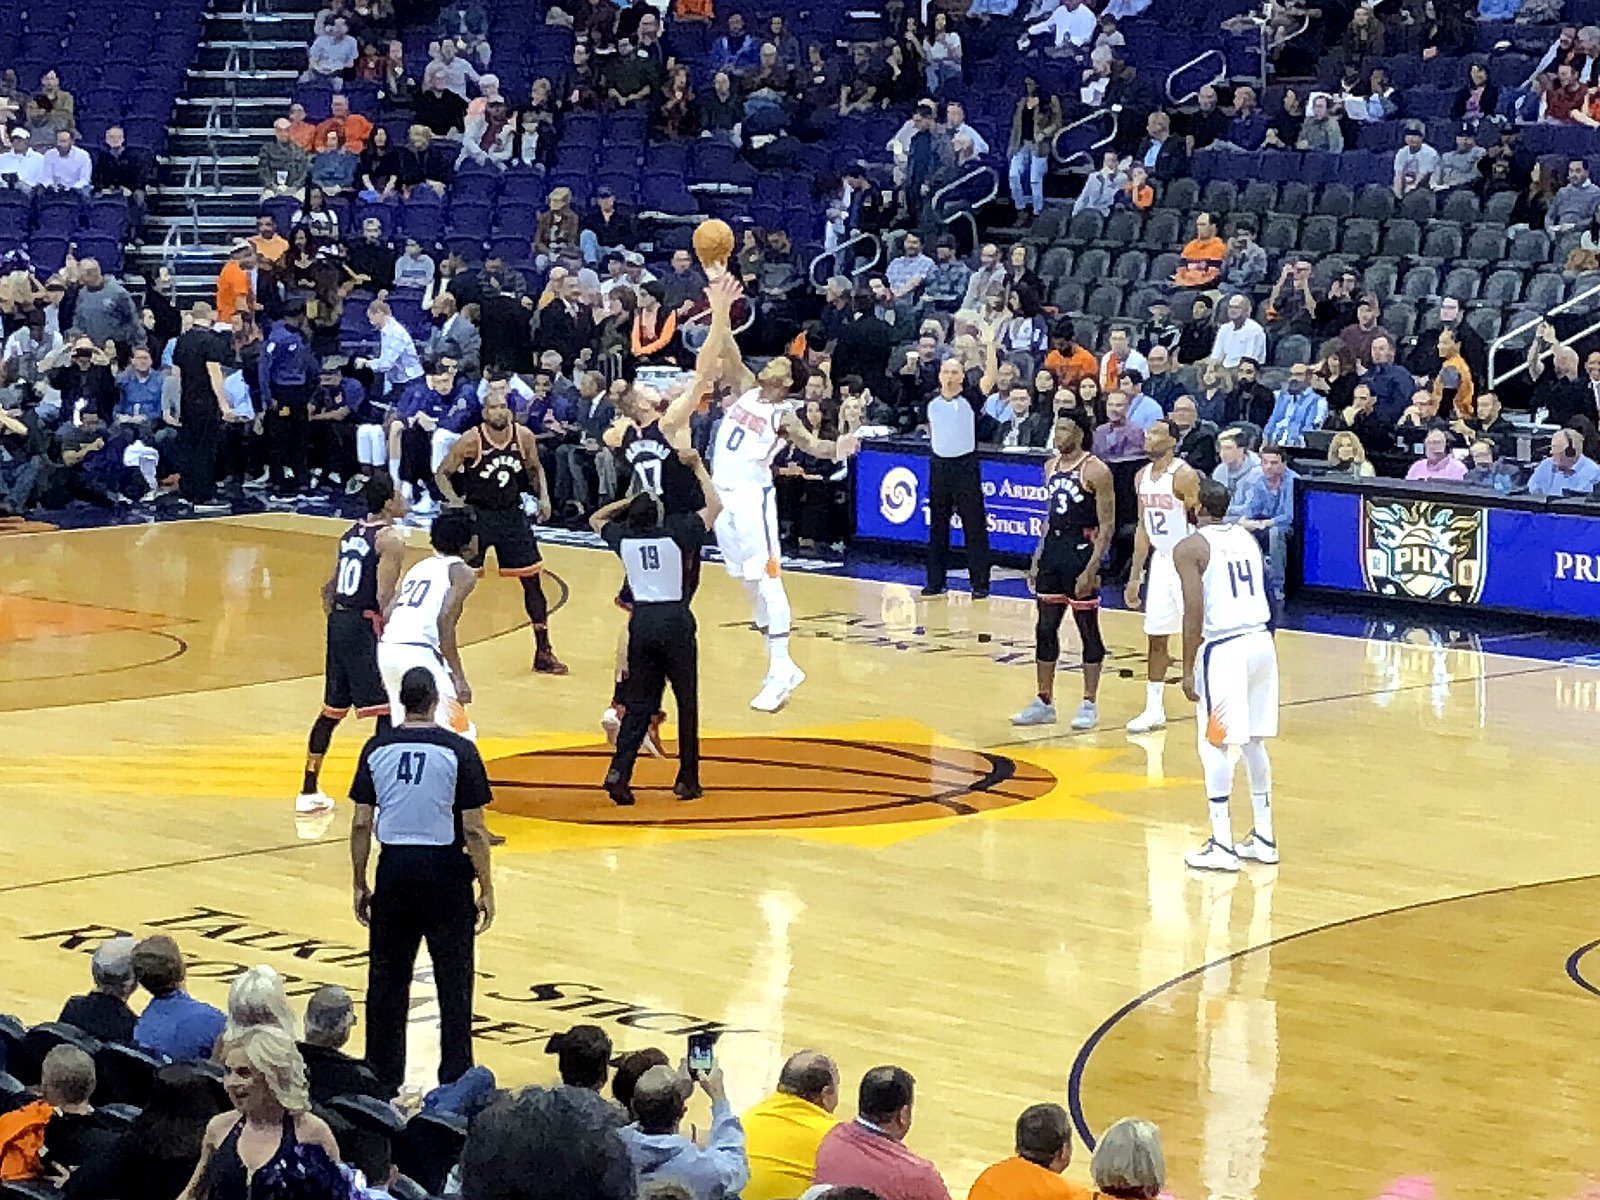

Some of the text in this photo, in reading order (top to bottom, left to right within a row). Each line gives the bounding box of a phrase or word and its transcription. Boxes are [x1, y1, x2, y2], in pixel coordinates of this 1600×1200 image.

[726, 426, 746, 452] 0
[497, 470, 510, 488] 9
[634, 459, 665, 496] 17
[999, 478, 1050, 501] ARIZO
[1056, 493, 1068, 515] 3
[1147, 510, 1169, 536] 12
[639, 545, 660, 570] 19
[1394, 546, 1450, 577] PHX
[337, 556, 363, 597] 10
[1227, 559, 1255, 599] 14
[397, 579, 432, 608] 20
[396, 751, 427, 785] 47
